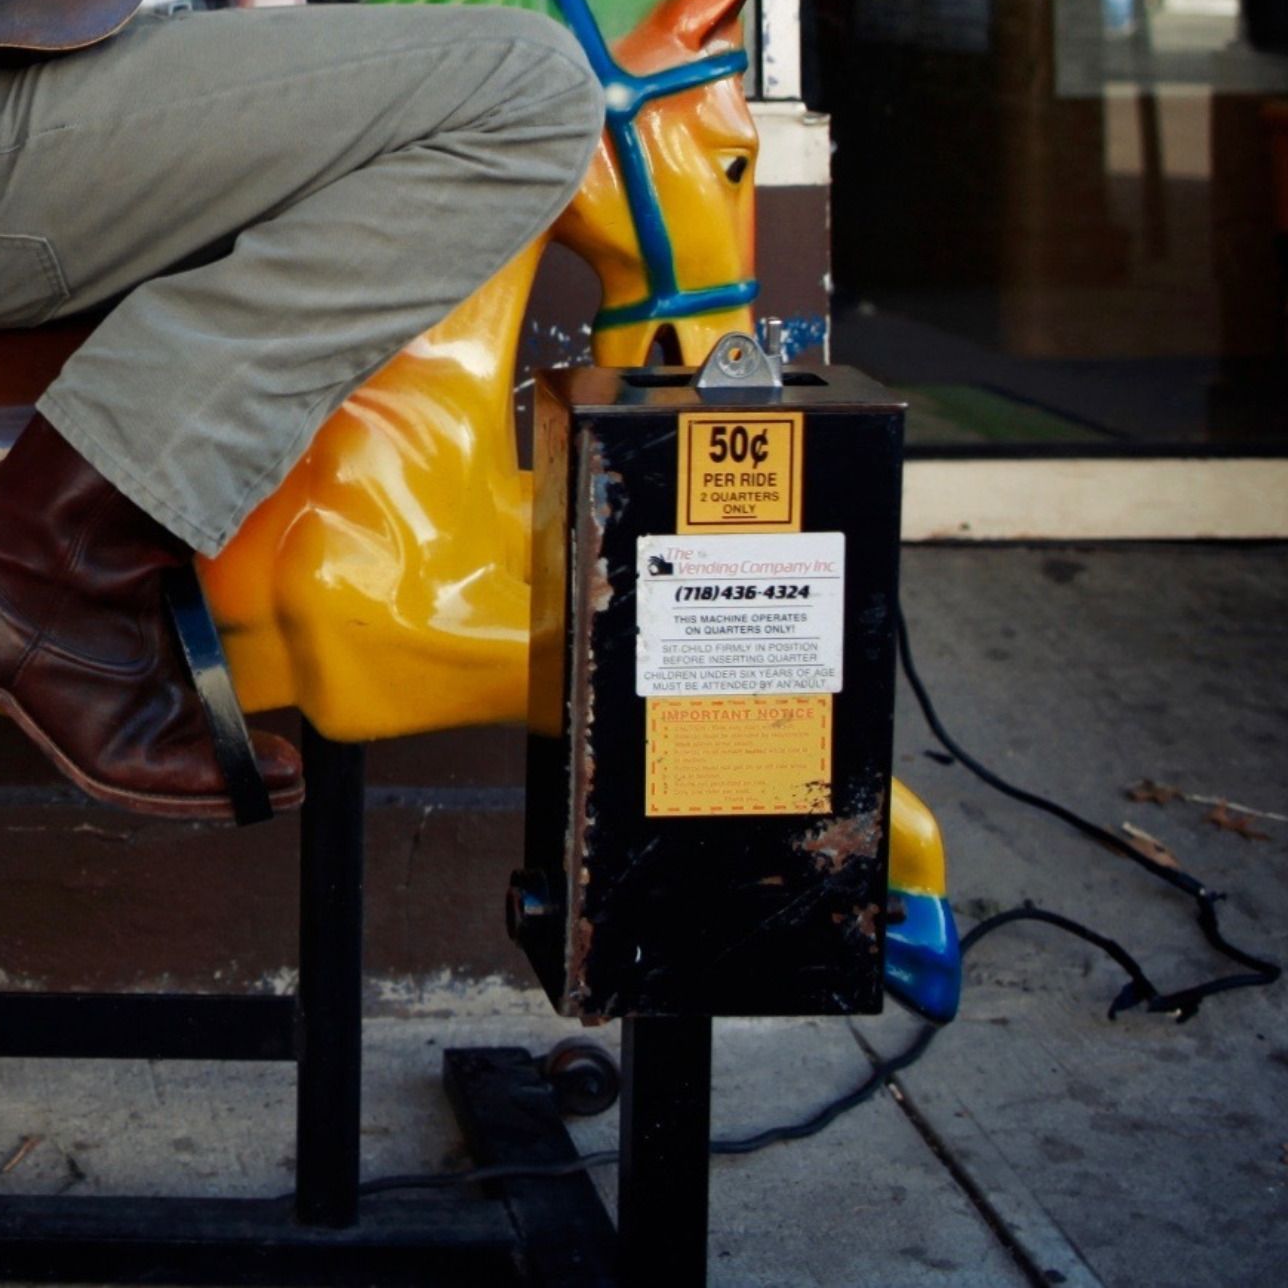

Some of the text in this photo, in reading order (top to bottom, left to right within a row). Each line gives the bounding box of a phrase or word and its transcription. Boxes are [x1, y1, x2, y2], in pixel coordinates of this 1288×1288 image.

[709, 425, 768, 469] 50¢
[703, 472, 777, 487] PER RIDE
[700, 491, 780, 502] 2 QUARTERS
[722, 504, 756, 514] ONLY
[666, 547, 694, 560] The
[678, 559, 834, 577] Vending Company Inc
[675, 584, 810, 602] (718)436-4324
[674, 613, 808, 624] THIS MACHINE OPERATES
[685, 624, 795, 636] ON QUARTERS ONLY!
[663, 642, 818, 654] SIT CHILD FIRMLY IN POSITION
[663, 653, 817, 665] BEFORE INSERTING QUARTER
[644, 668, 835, 680] CHILDREN UNDER SIX YEARS OF AGE
[652, 679, 825, 691] MUST BE ATTENDED BY AN ADULT
[663, 708, 815, 721] IMPORTANT NOTICE
